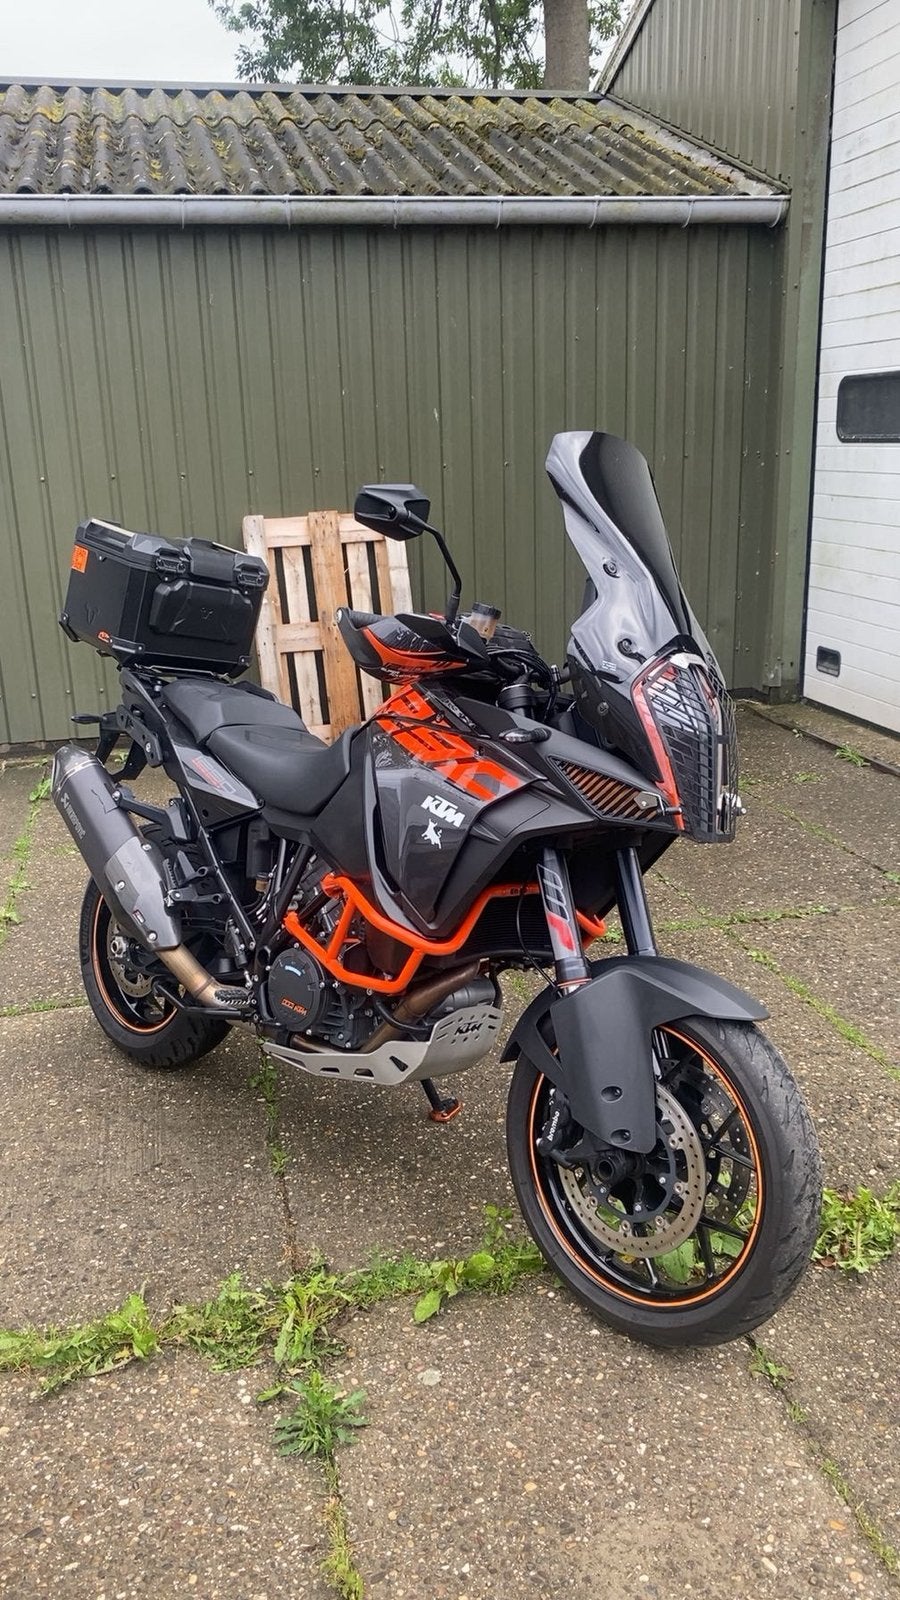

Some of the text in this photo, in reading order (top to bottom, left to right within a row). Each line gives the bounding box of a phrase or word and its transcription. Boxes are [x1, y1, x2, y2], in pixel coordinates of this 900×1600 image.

[421, 794, 466, 828] KTM
[454, 1021, 484, 1035] KTM
[546, 1110, 561, 1141] brembo
